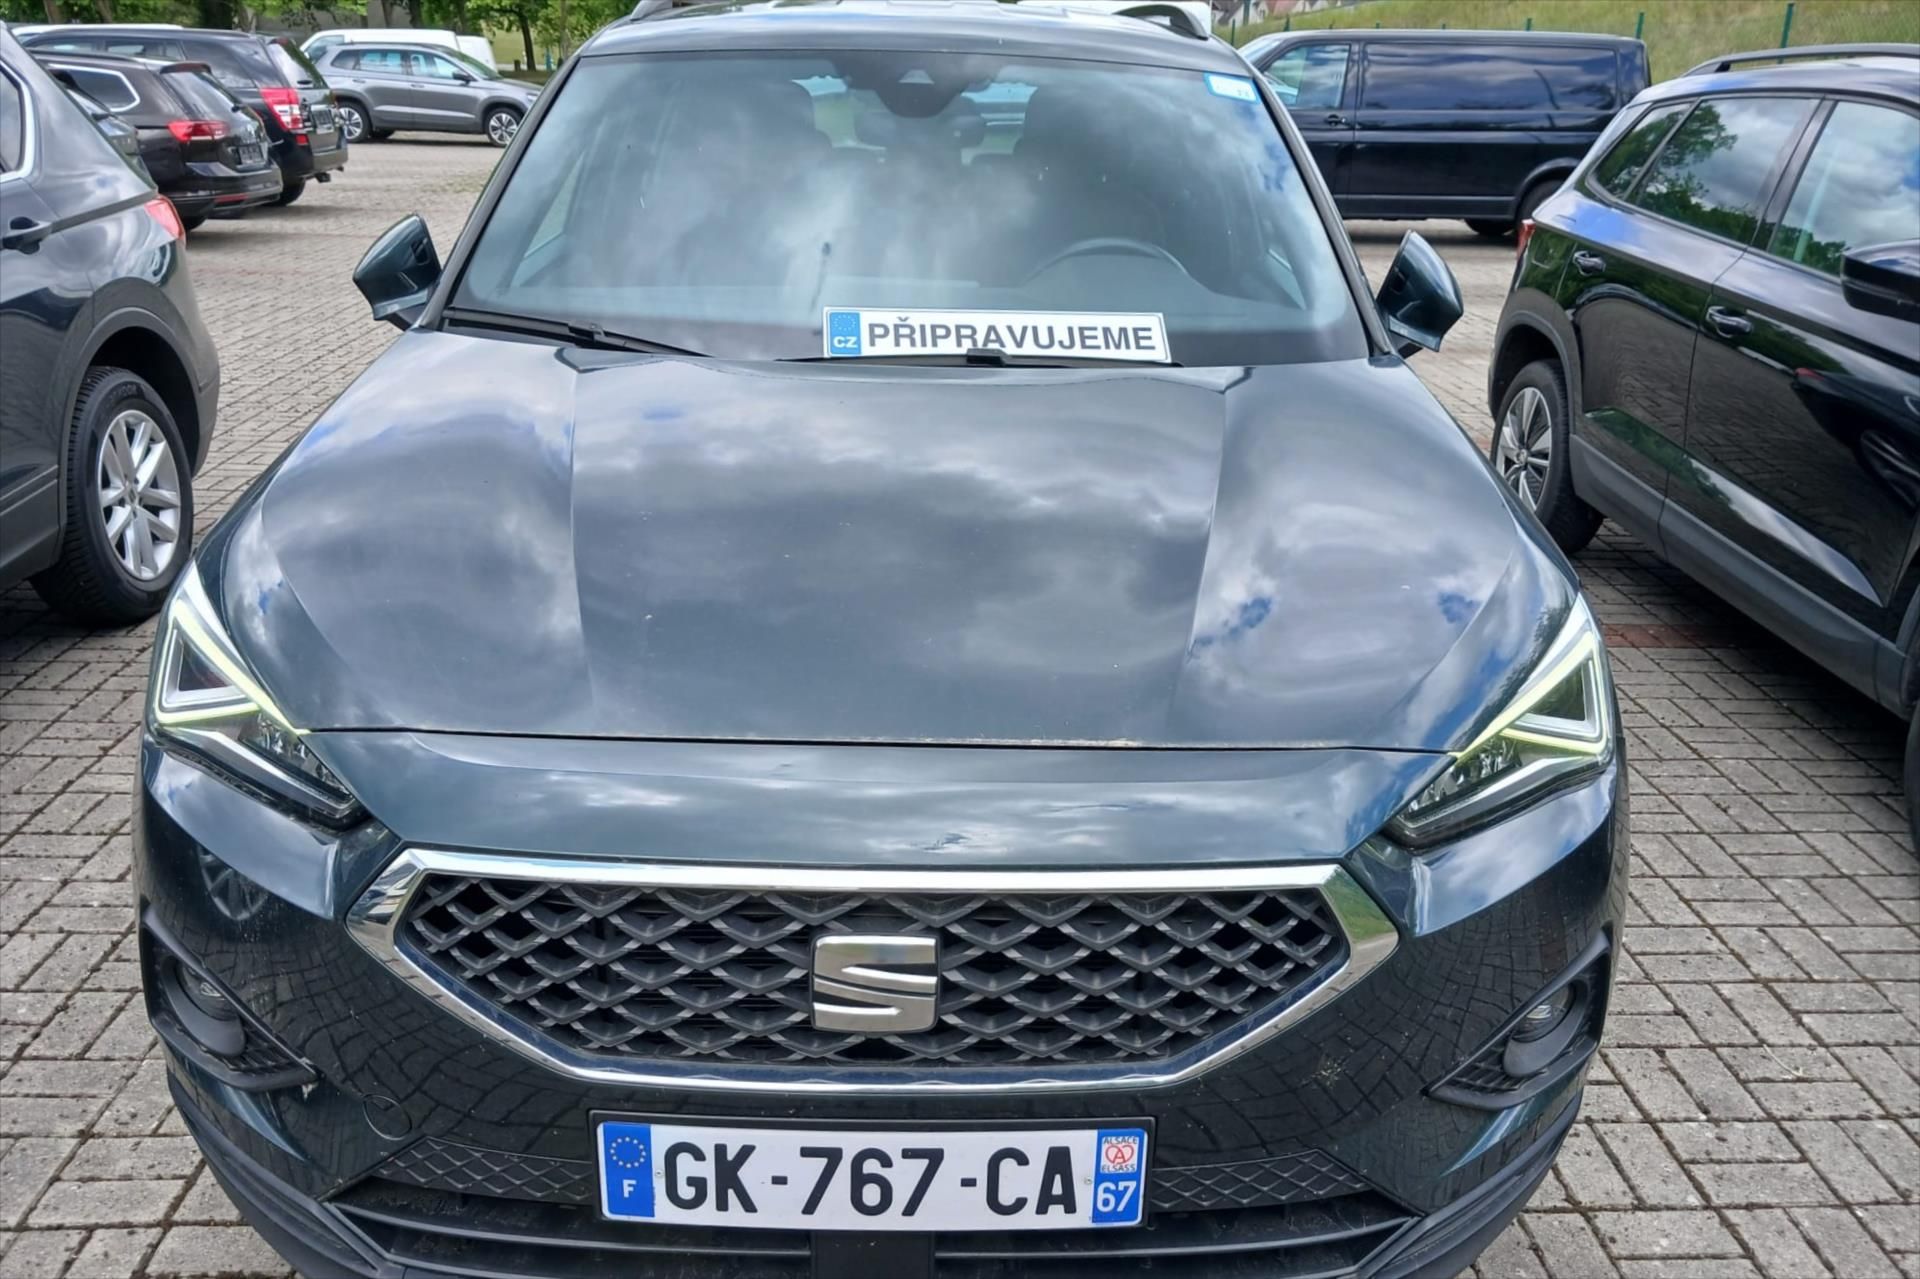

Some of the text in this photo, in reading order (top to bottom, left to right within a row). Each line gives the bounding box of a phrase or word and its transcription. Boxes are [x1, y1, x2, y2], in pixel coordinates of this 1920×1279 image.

[833, 336, 858, 348] CZ
[868, 315, 1157, 350] PŘIPRAVUJEME
[622, 1179, 637, 1198] F
[1096, 1181, 1137, 1212] 67
